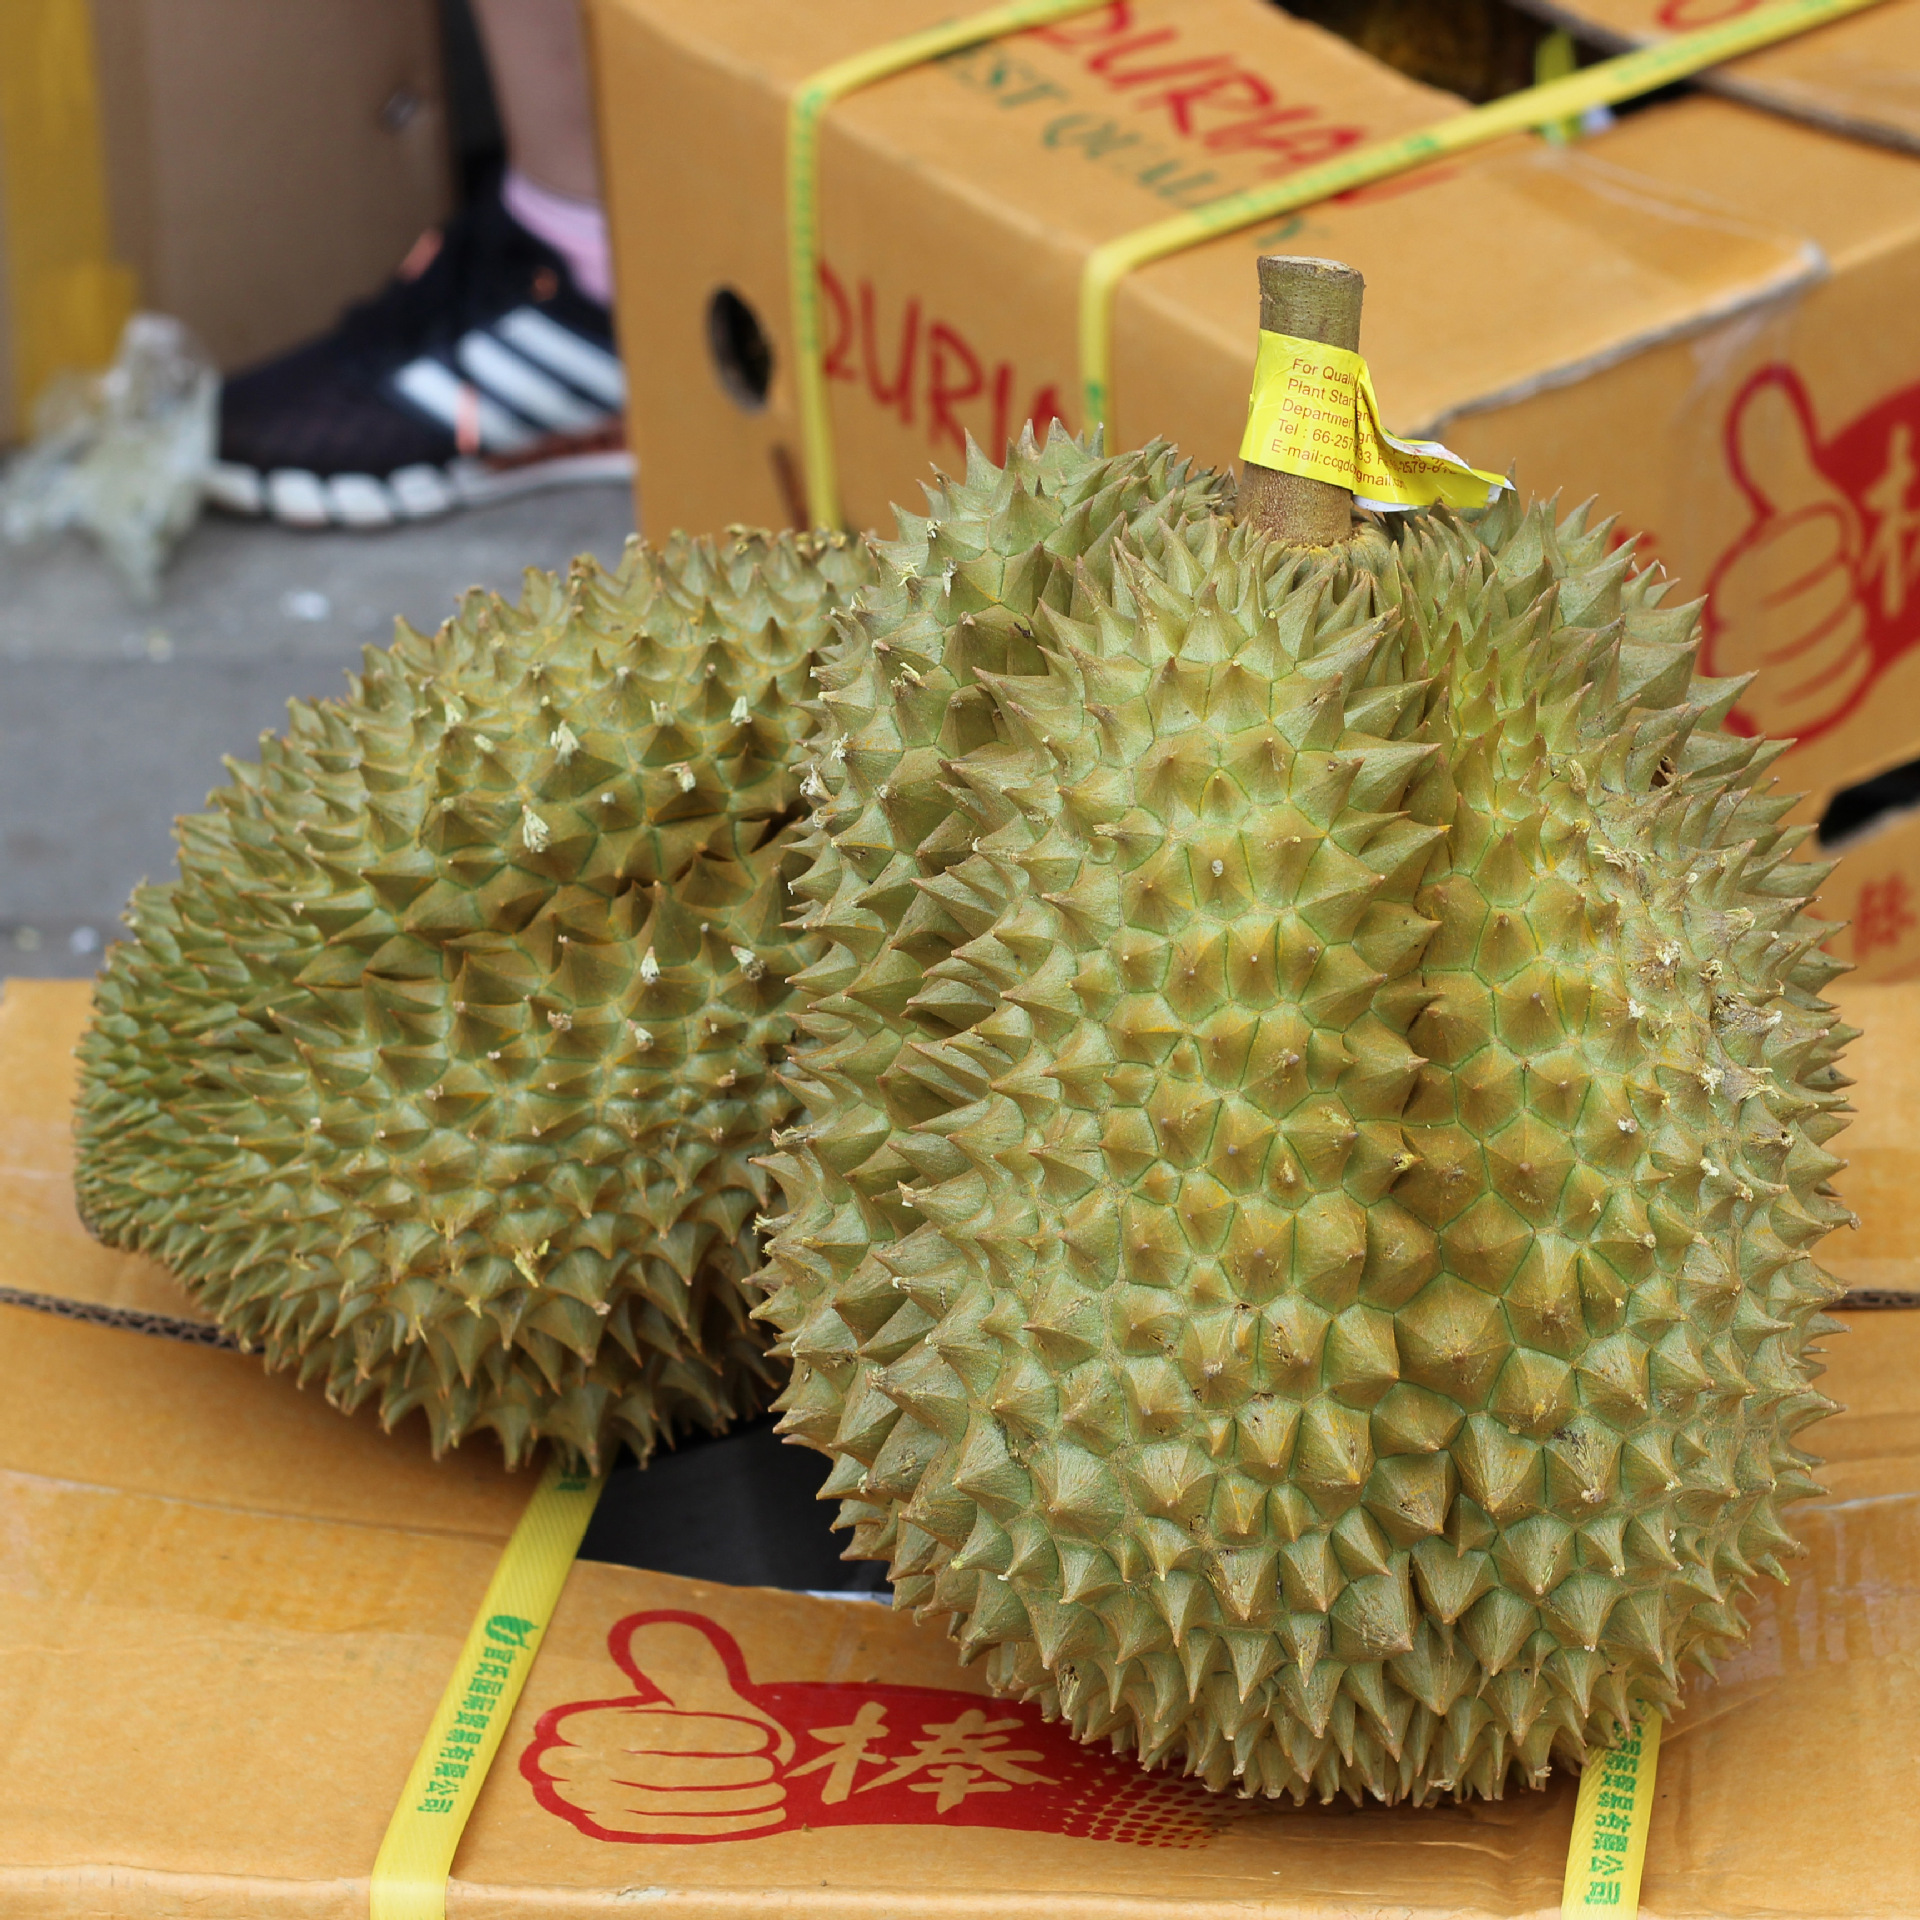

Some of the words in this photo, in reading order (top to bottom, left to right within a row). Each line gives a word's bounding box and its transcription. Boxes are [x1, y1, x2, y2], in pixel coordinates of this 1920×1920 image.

[1016, 0, 1466, 207] DURIA
[1292, 358, 1319, 376] For
[1287, 378, 1326, 400] Plant
[1278, 418, 1299, 436] Tel
[1282, 398, 1355, 430] Departmen
[785, 1700, 1060, 1815] 棒
